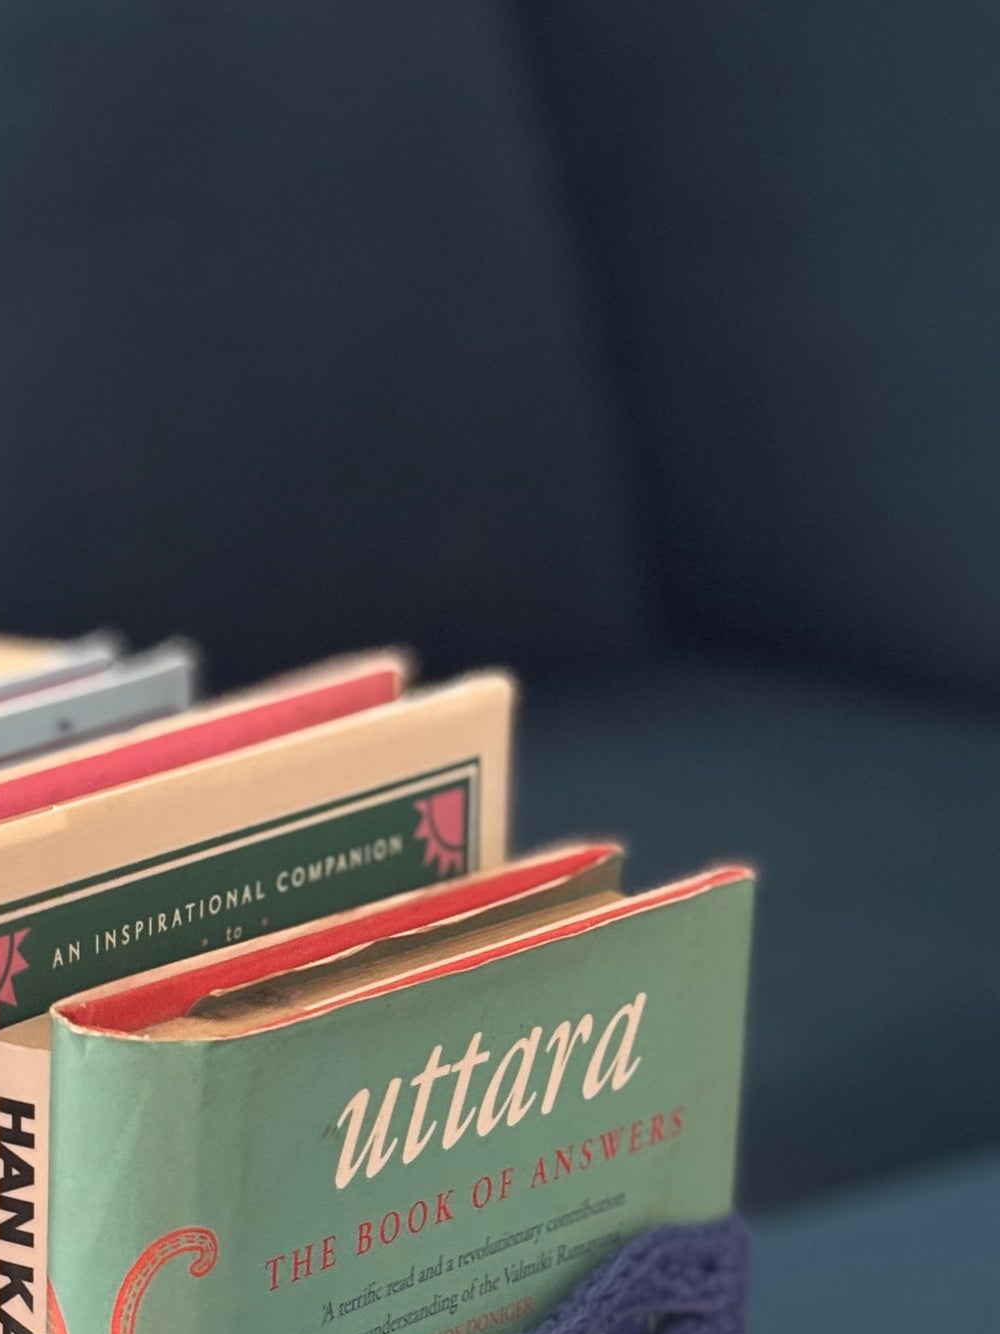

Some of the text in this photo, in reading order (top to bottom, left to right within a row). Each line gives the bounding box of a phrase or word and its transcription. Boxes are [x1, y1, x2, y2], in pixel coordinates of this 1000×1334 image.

[53, 834, 403, 969] AN INSPIRATIONAL COMPANION
[226, 926, 243, 942] to
[334, 992, 647, 1190] uttara
[264, 1106, 686, 1292] THE BOOK OF ANSWERS
[338, 1281, 384, 1316] terrific
[385, 1265, 415, 1298] read
[418, 1254, 444, 1284] and
[461, 1277, 480, 1303] of
[479, 1274, 501, 1297] the
